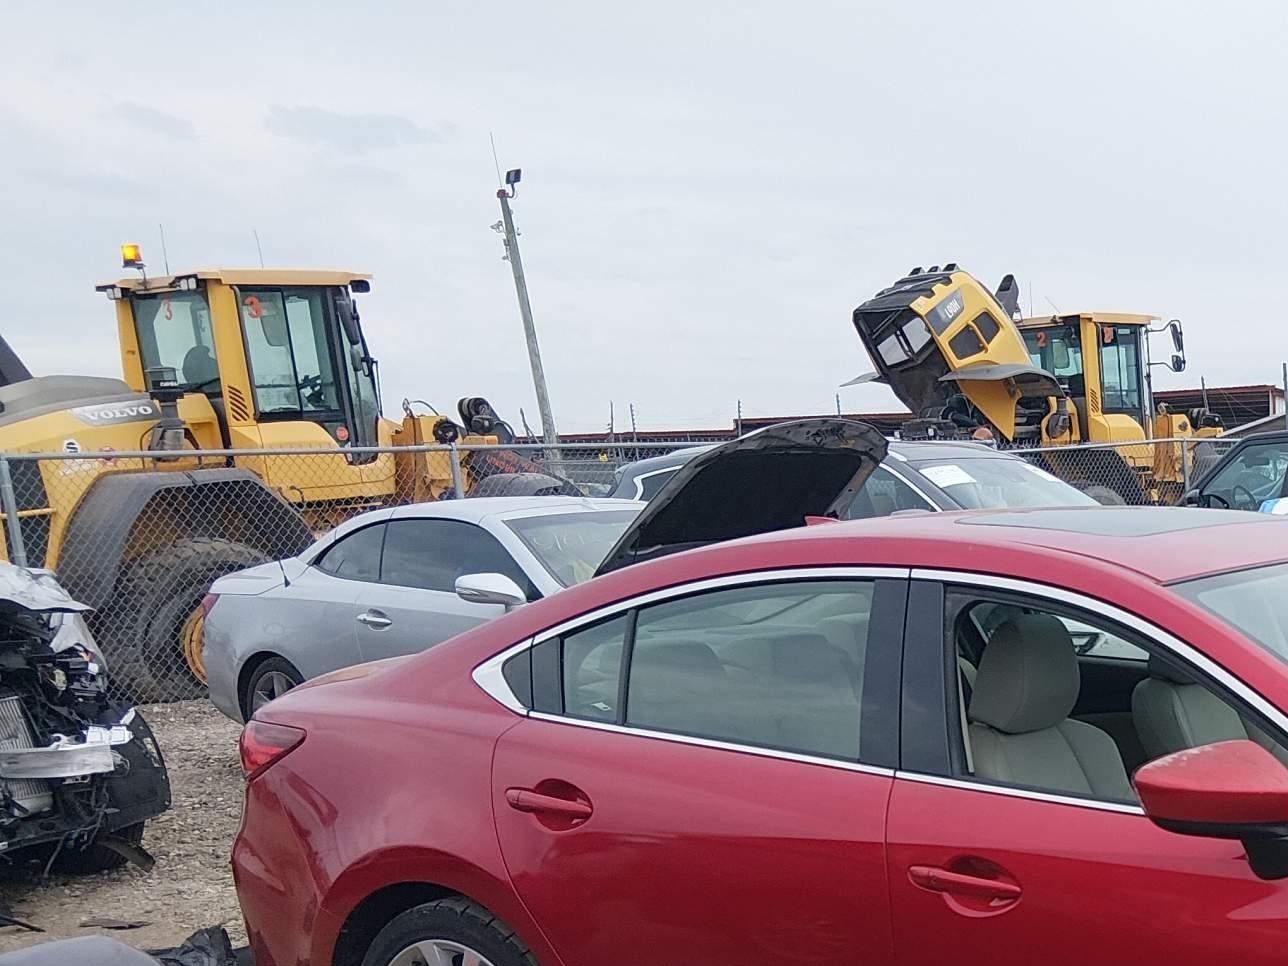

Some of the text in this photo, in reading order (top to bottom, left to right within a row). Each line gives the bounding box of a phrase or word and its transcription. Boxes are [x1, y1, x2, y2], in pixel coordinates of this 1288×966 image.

[244, 295, 263, 318] 3
[1036, 332, 1046, 347] 2
[84, 405, 153, 420] VOLVO
